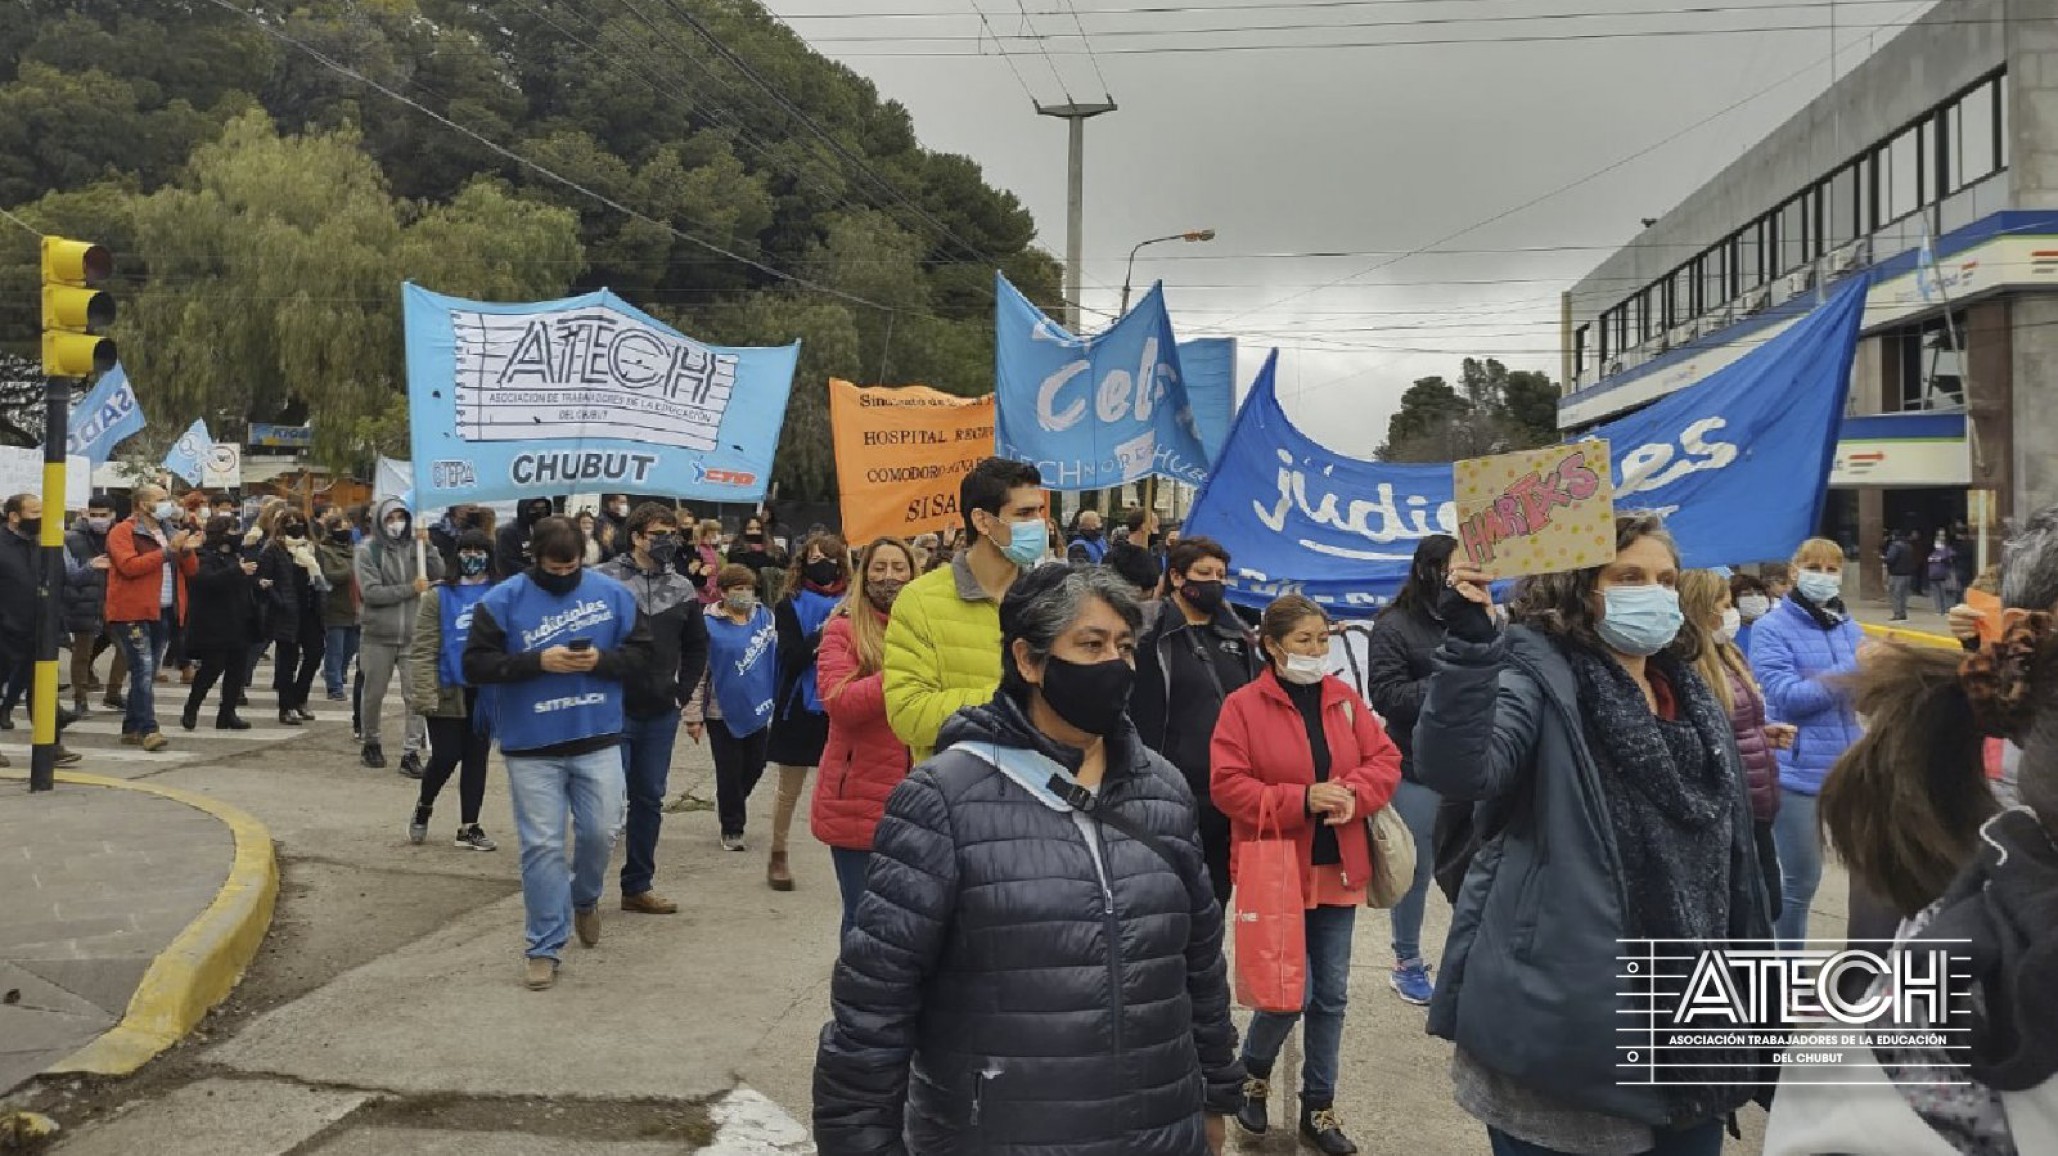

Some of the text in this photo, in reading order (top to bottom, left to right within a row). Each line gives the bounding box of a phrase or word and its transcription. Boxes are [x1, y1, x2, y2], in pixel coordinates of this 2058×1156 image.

[497, 315, 716, 404] ATECH
[863, 430, 948, 446] HOSPITAL
[512, 453, 655, 484] CHUBUT
[1459, 451, 1599, 563] HARTXS
[522, 600, 608, 652] judiciales
